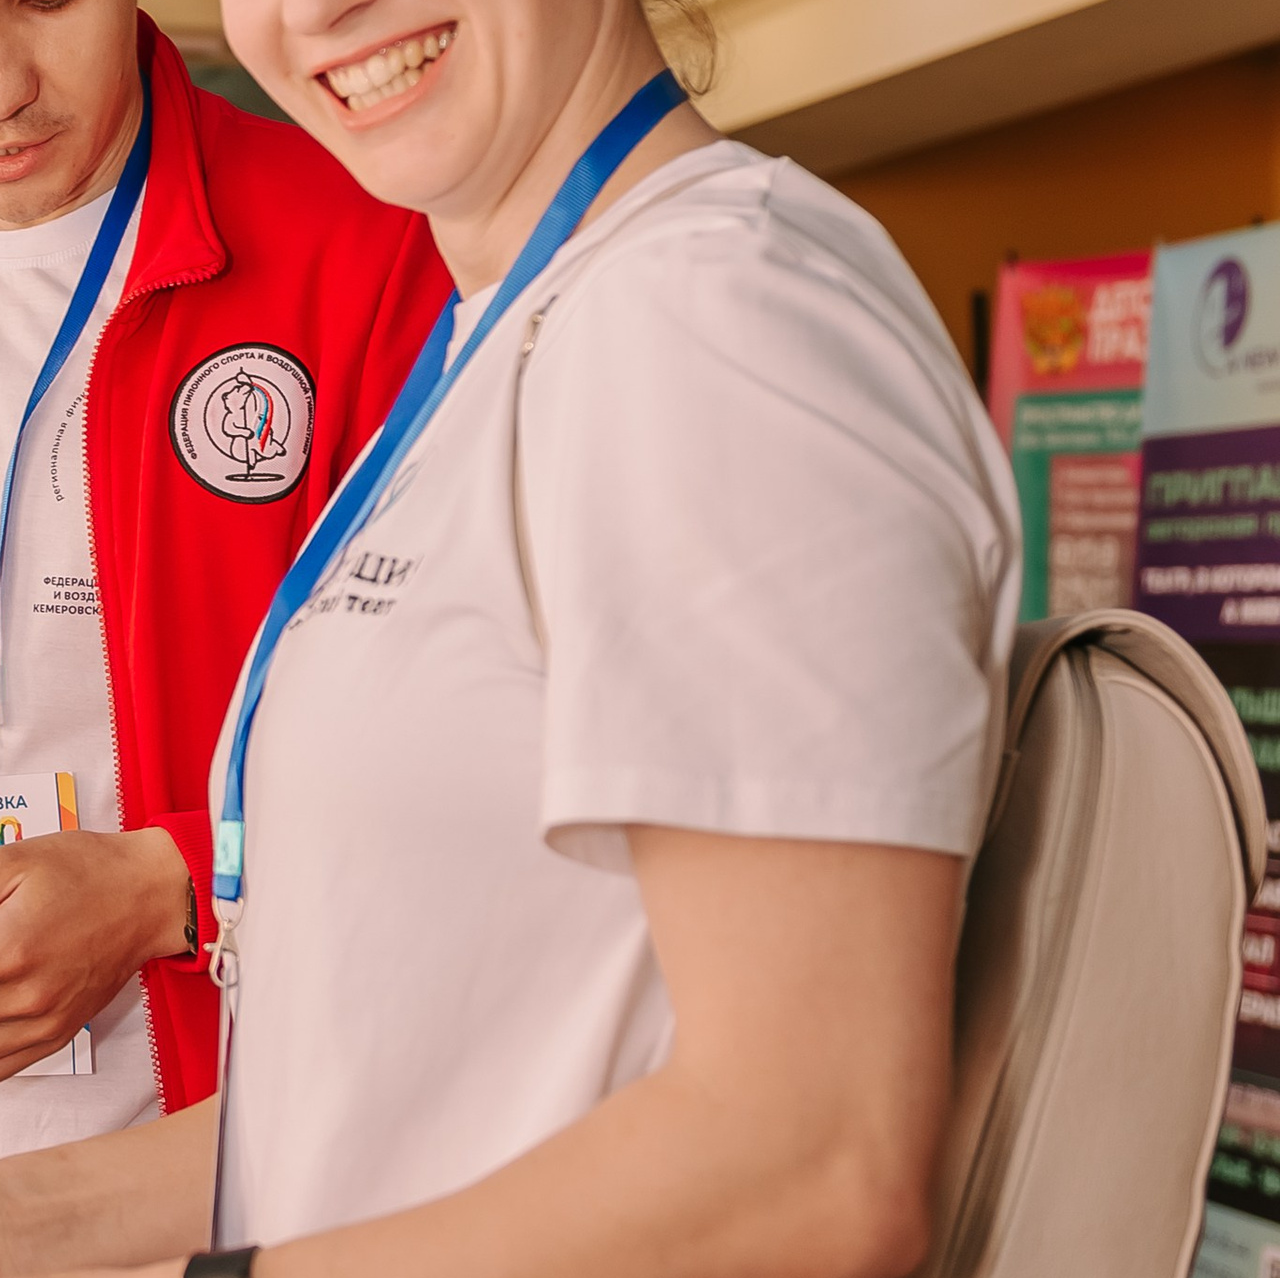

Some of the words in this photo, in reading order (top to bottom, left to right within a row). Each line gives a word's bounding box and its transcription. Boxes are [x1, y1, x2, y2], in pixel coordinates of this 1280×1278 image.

[220, 351, 256, 366] СПОРТА
[266, 353, 312, 396] ВОЗДУШНОЙ
[183, 361, 220, 407] ПИЛОННОГО
[180, 408, 198, 460] ФЕДЕРАЦИЯ
[50, 422, 68, 502] региональная
[53, 591, 61, 600] И
